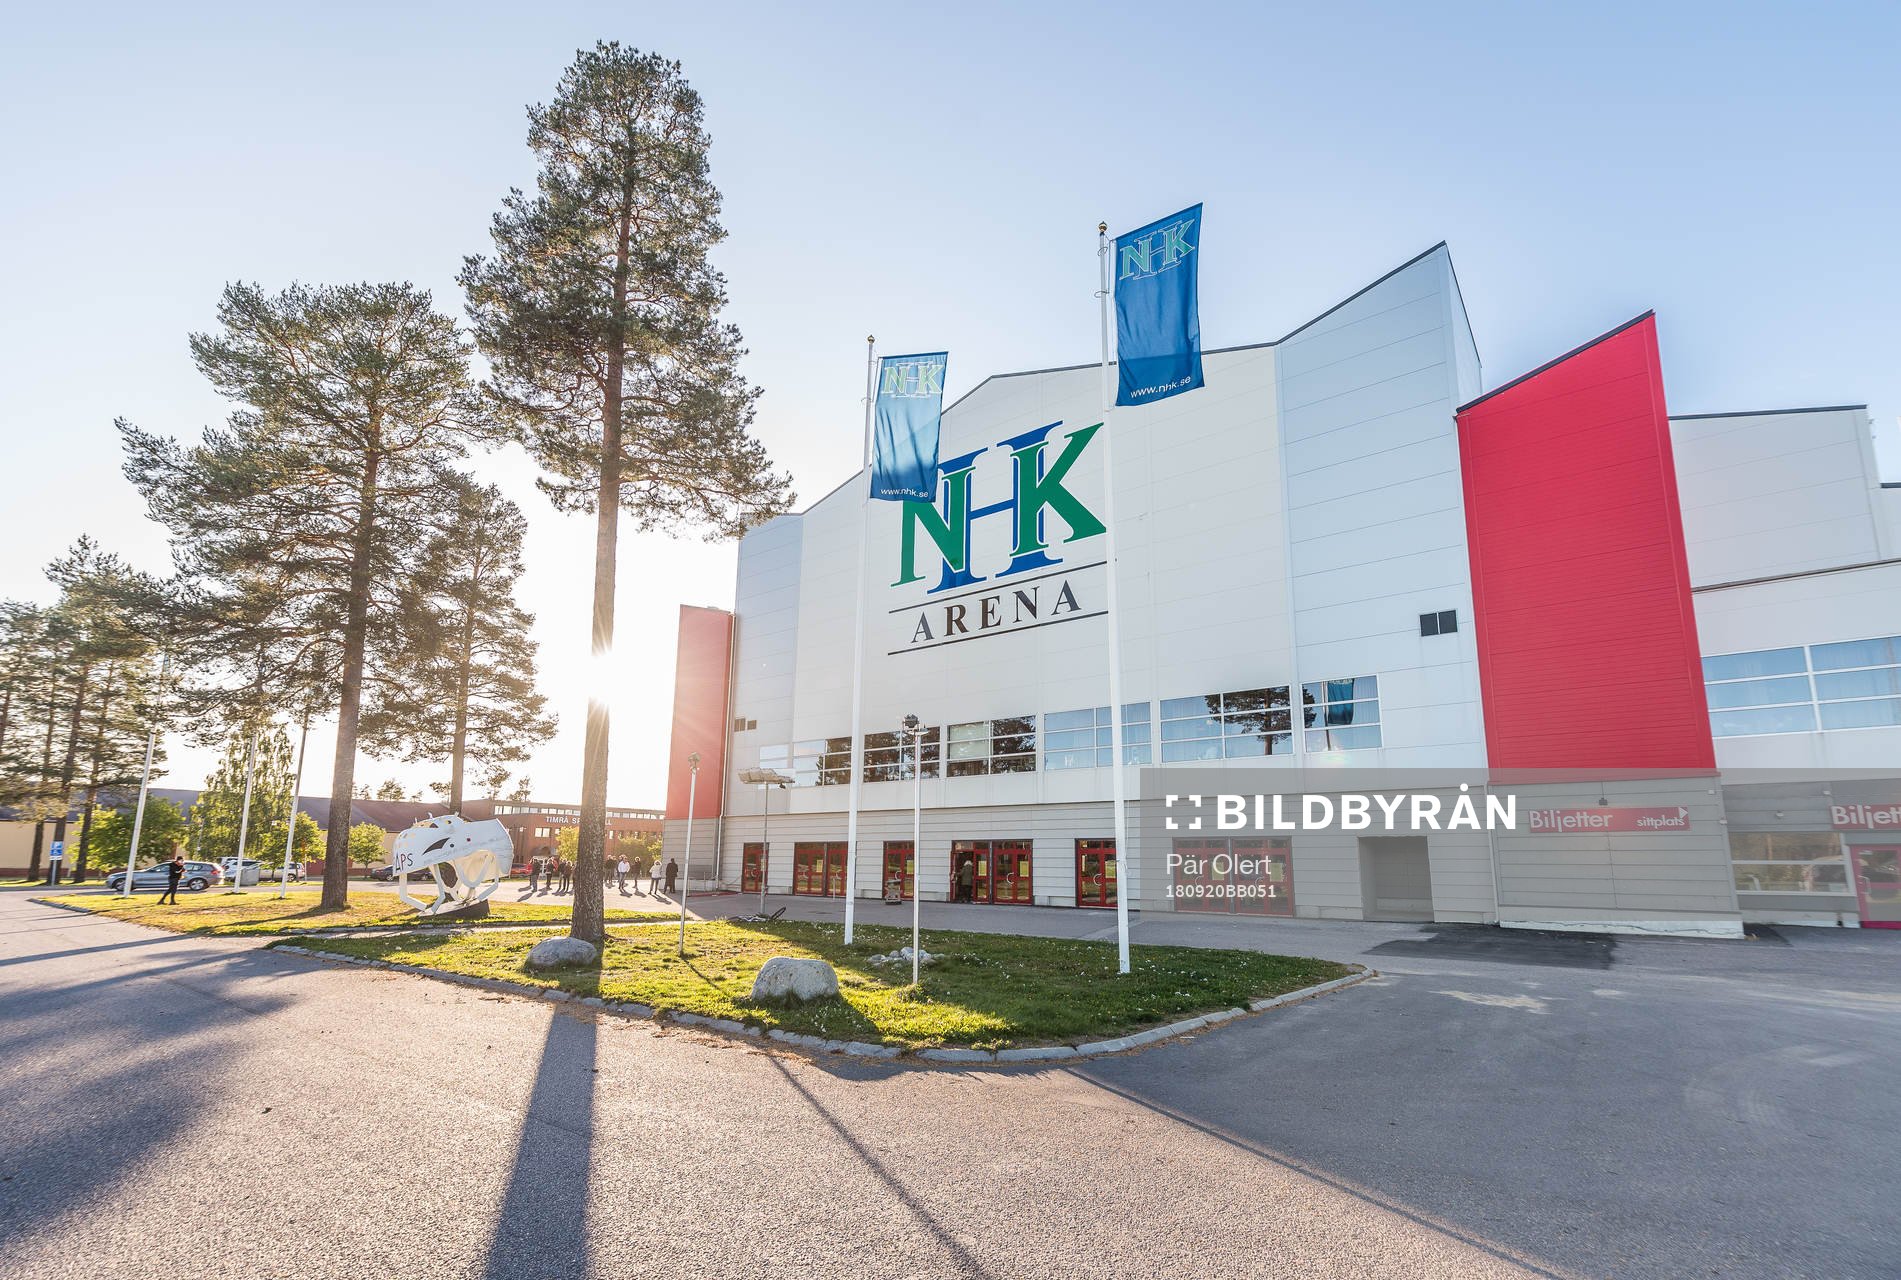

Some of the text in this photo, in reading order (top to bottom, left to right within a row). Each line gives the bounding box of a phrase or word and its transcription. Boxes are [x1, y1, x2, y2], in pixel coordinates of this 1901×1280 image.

[1119, 218, 1196, 280] NHK
[881, 361, 944, 399] NHK
[1130, 375, 1192, 398] www.nhk.se
[880, 487, 929, 499] www.nhk.se
[890, 420, 1107, 594] NHK
[911, 579, 1082, 643] ARENA
[545, 816, 569, 824] TIMRÅ
[1529, 810, 1685, 832] Biljetter sittplats
